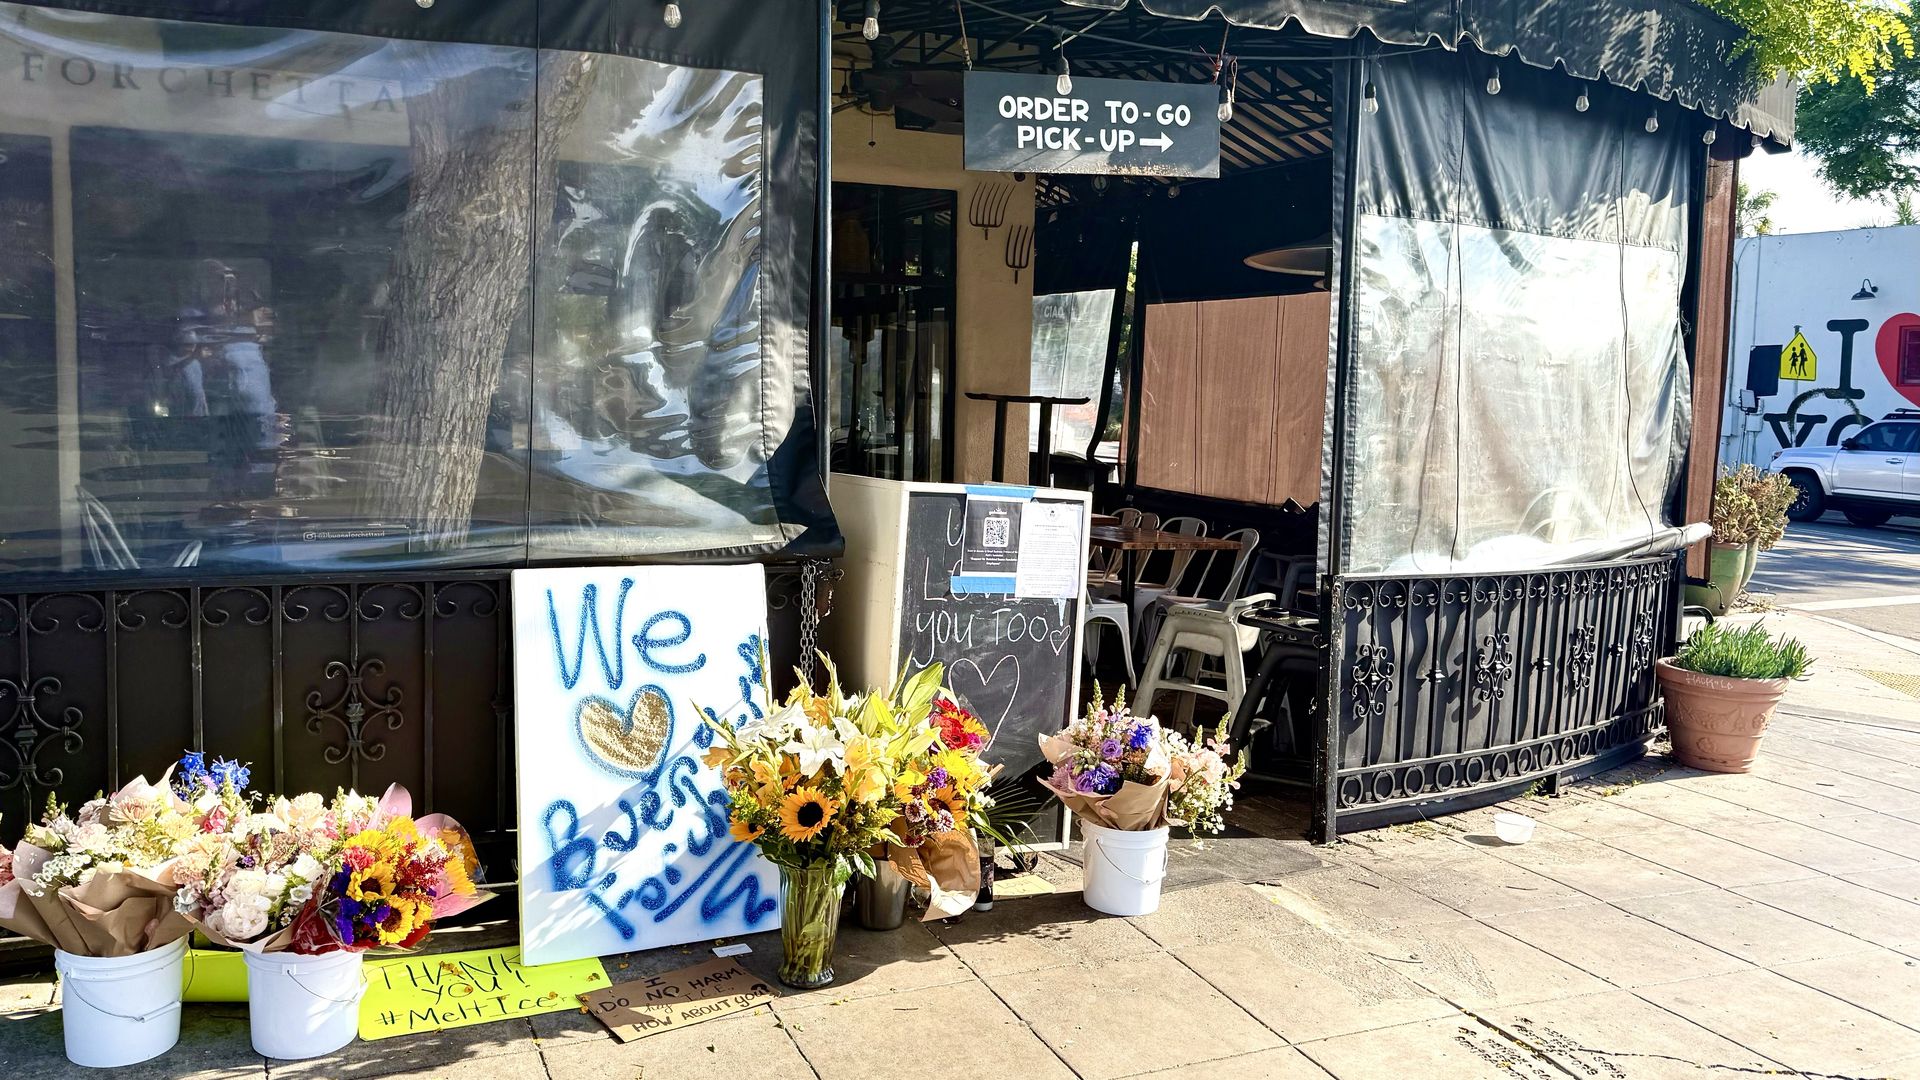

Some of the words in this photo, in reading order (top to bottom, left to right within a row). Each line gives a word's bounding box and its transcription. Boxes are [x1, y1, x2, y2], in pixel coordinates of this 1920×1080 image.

[21, 50, 400, 112] FORCHETTA
[998, 95, 1090, 122] ORDER
[1105, 100, 1191, 127] TO-GO
[1017, 125, 1135, 153] PICK-UP
[1826, 319, 1869, 400] I
[546, 577, 707, 690] We
[992, 608, 1049, 645] TOO
[366, 953, 520, 989] THANK
[598, 997, 630, 1013] DO
[645, 985, 680, 1001] NO
[631, 1015, 673, 1033] HOW
[680, 999, 732, 1021] ABOUT
